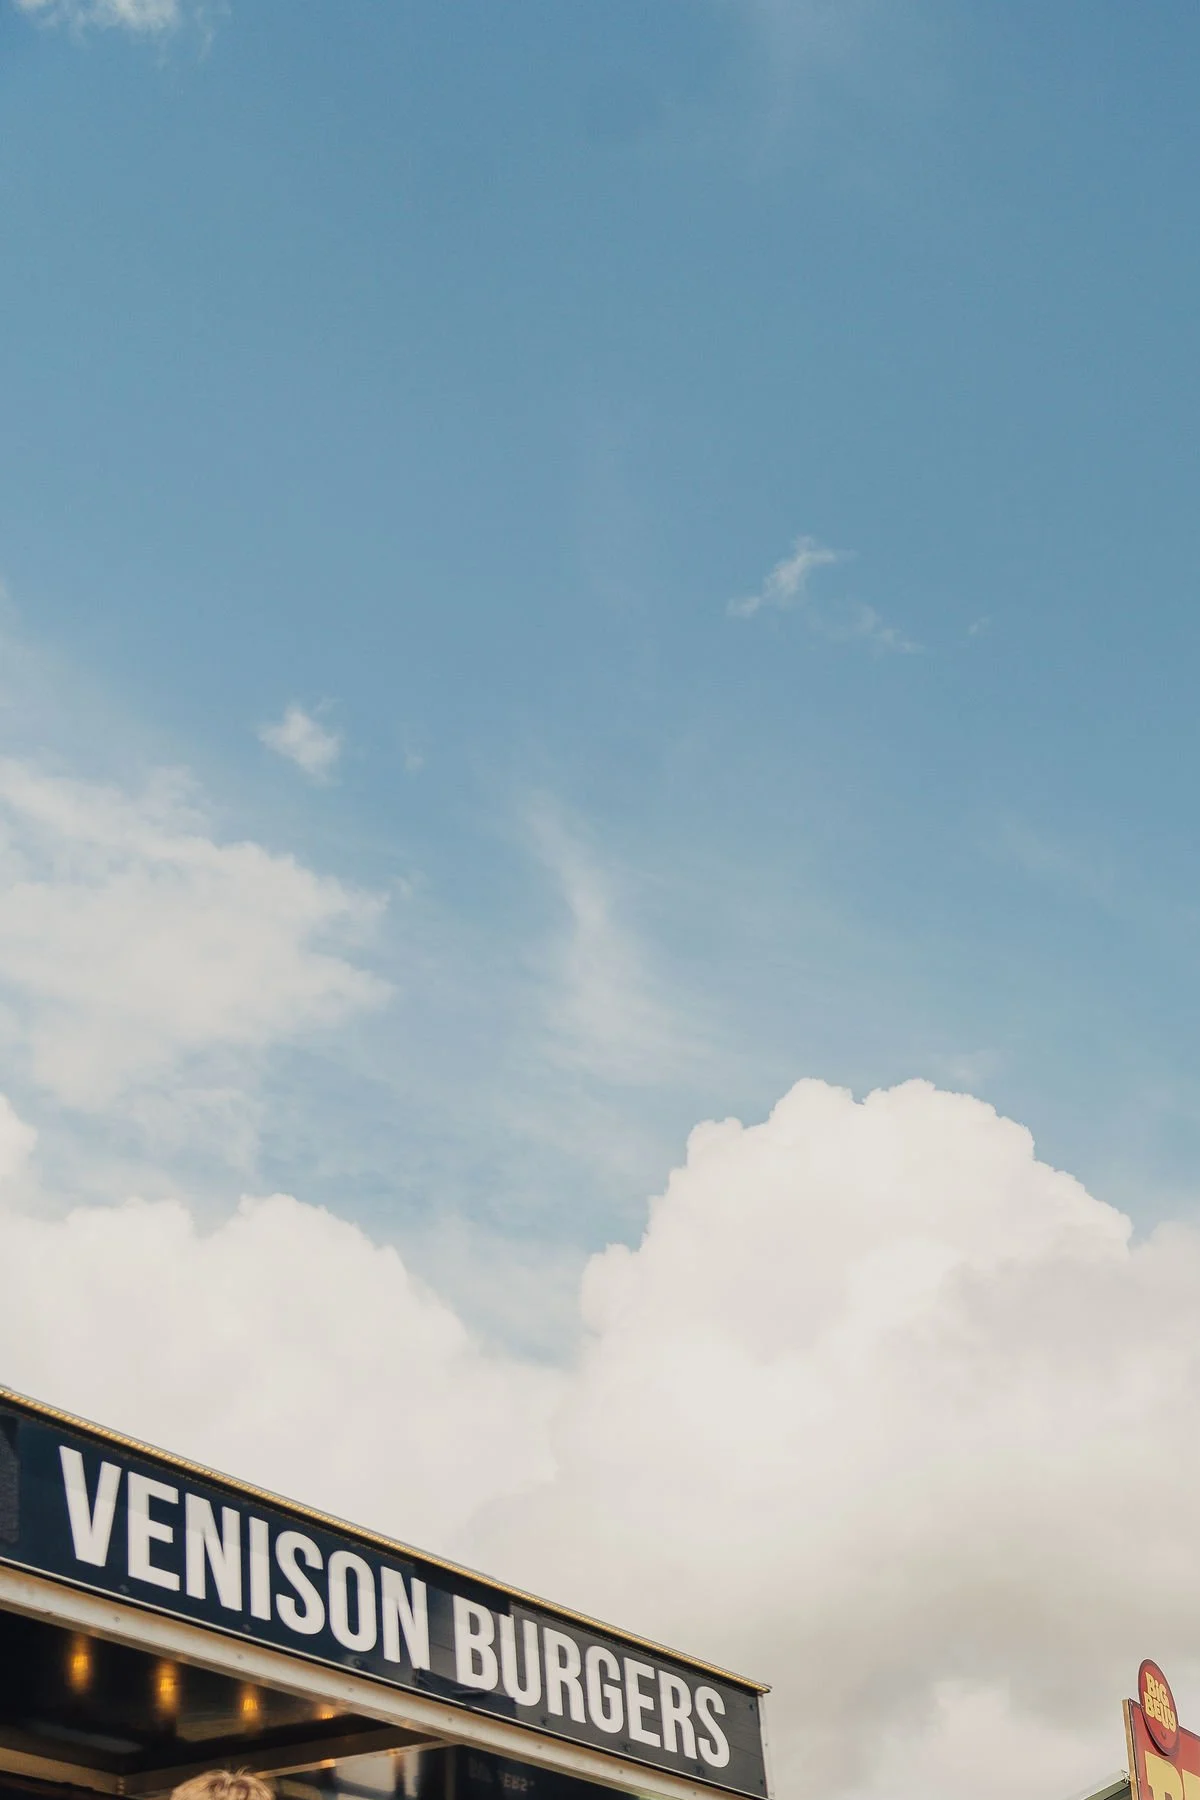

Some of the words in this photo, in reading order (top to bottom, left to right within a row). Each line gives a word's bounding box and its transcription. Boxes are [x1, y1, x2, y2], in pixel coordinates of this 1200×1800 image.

[58, 1445, 429, 1671] VENISON
[452, 1594, 731, 1769] BURGERS
[1145, 1671, 1170, 1708] BIG
[1144, 1691, 1177, 1733] BELLY
